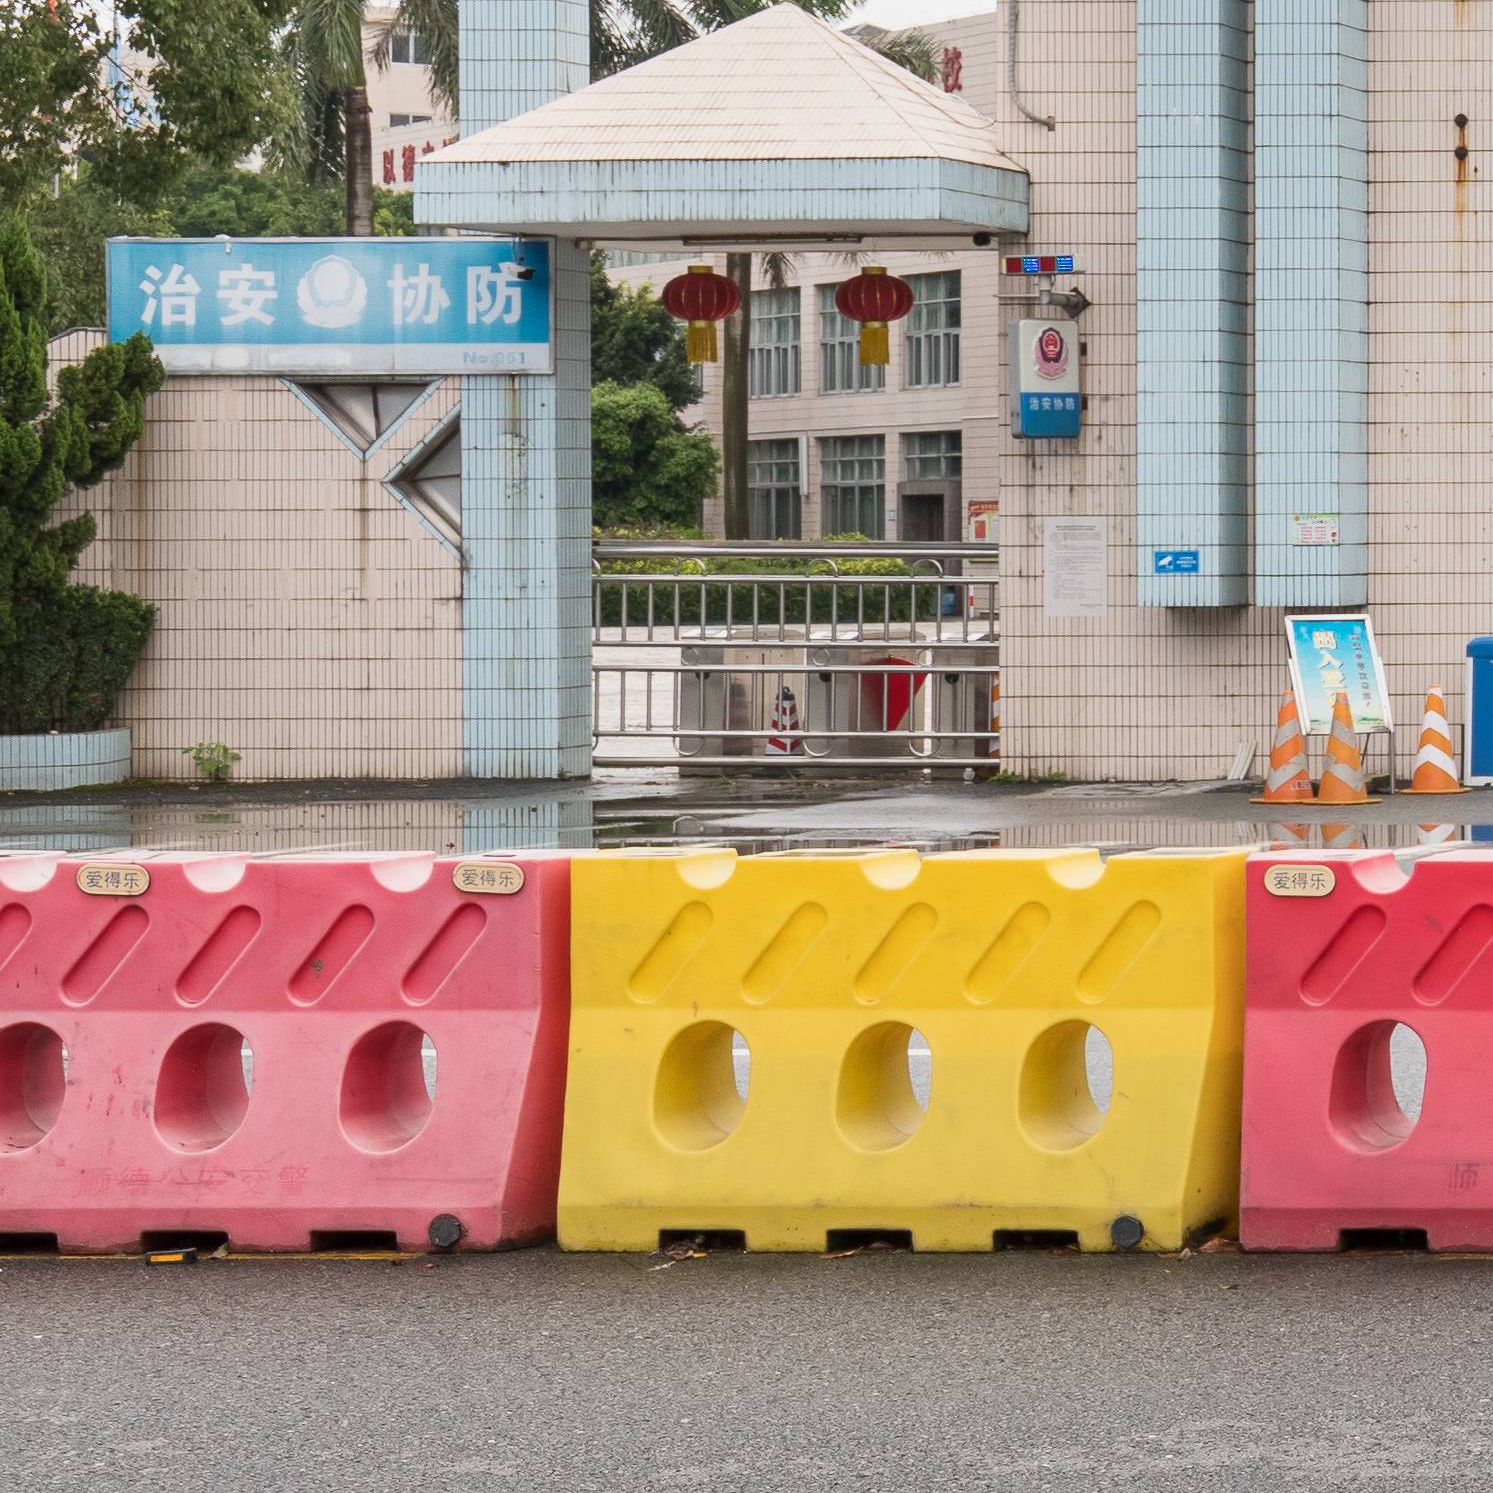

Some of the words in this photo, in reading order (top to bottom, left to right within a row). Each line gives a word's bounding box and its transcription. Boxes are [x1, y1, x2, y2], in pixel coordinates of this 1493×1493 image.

[139, 263, 279, 326] 治安
[388, 262, 523, 326] 协防
[86, 871, 139, 888] 爱得乐
[461, 870, 514, 887] 爱得乐
[1273, 872, 1326, 889] 爱得乐
